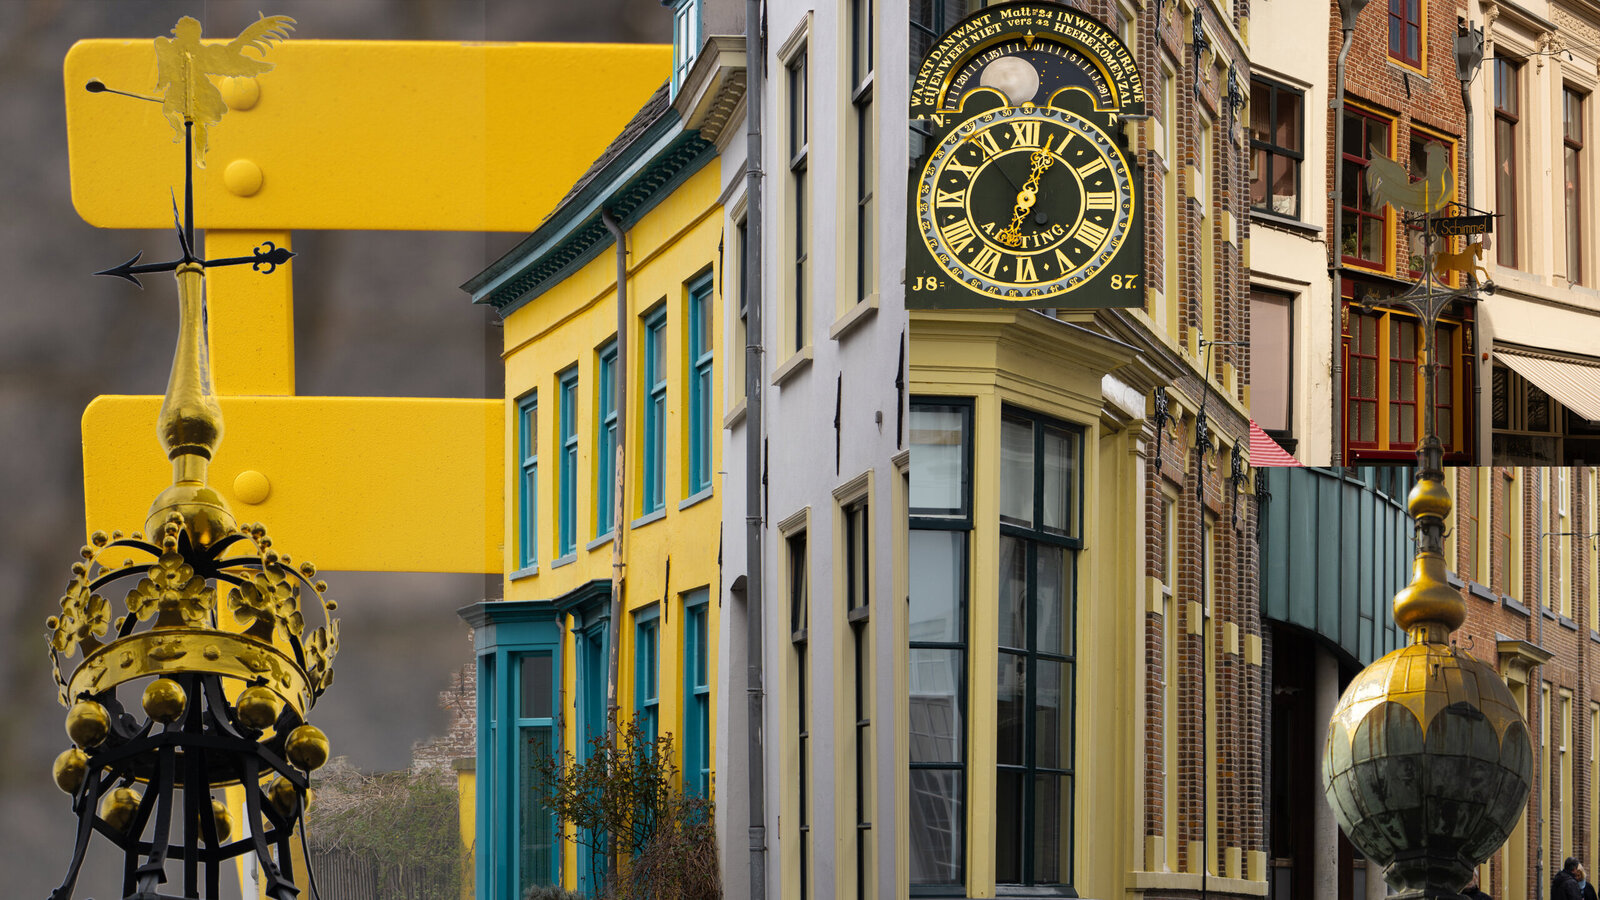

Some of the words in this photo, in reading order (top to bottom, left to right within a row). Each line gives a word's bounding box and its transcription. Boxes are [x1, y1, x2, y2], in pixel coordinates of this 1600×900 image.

[1006, 18, 1032, 27] vers
[1035, 19, 1050, 27] 42
[968, 129, 1002, 162] XI
[1010, 121, 1043, 148] XII
[1054, 130, 1077, 155] I
[944, 155, 979, 180] X
[1076, 156, 1108, 180] II
[936, 188, 965, 209] IX
[1087, 190, 1115, 211] III
[940, 217, 976, 256] VIII
[1073, 218, 1109, 251] IIII
[1441, 217, 1487, 235] Schimmel
[968, 243, 1002, 278] VII
[1014, 256, 1039, 282] VI
[1055, 248, 1077, 275] V
